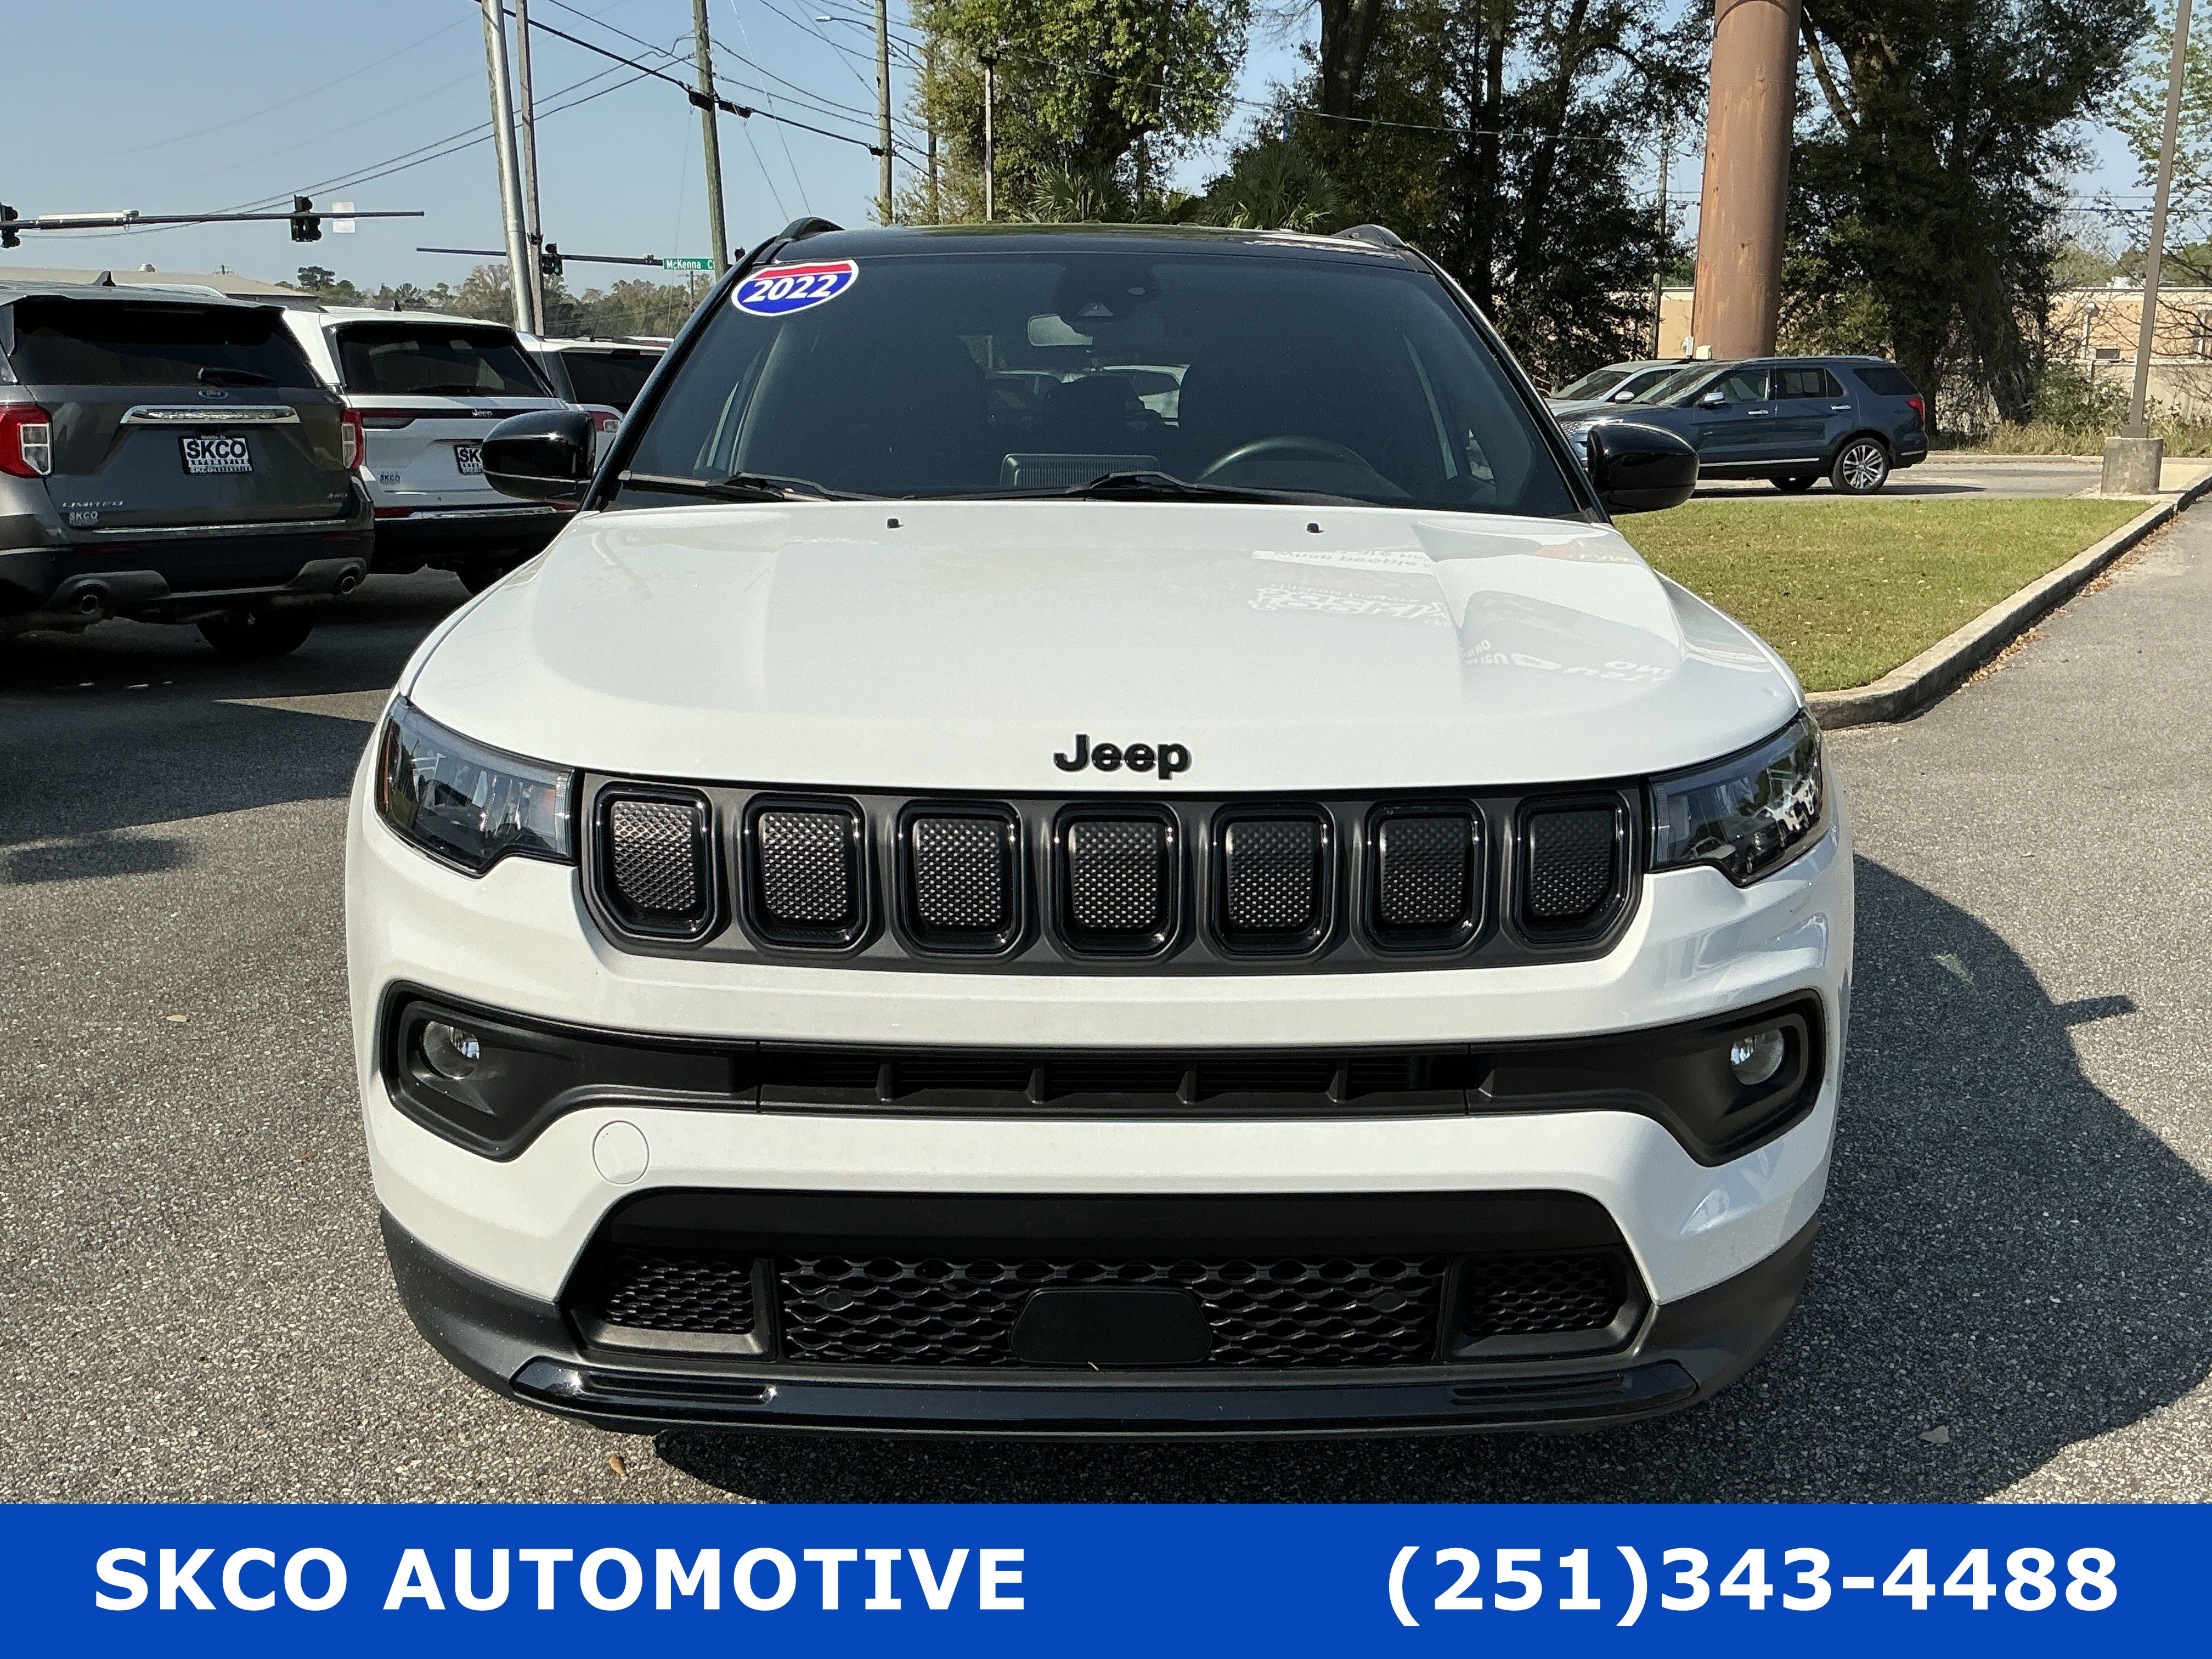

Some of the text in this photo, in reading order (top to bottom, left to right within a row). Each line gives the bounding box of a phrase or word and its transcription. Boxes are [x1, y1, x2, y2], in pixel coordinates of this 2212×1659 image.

[666, 259, 701, 269] McKenna
[742, 274, 838, 303] 2022
[187, 440, 246, 459] SKCO
[460, 448, 483, 462] SK
[69, 511, 98, 520] SKCO
[1053, 733, 1192, 780] Jeep
